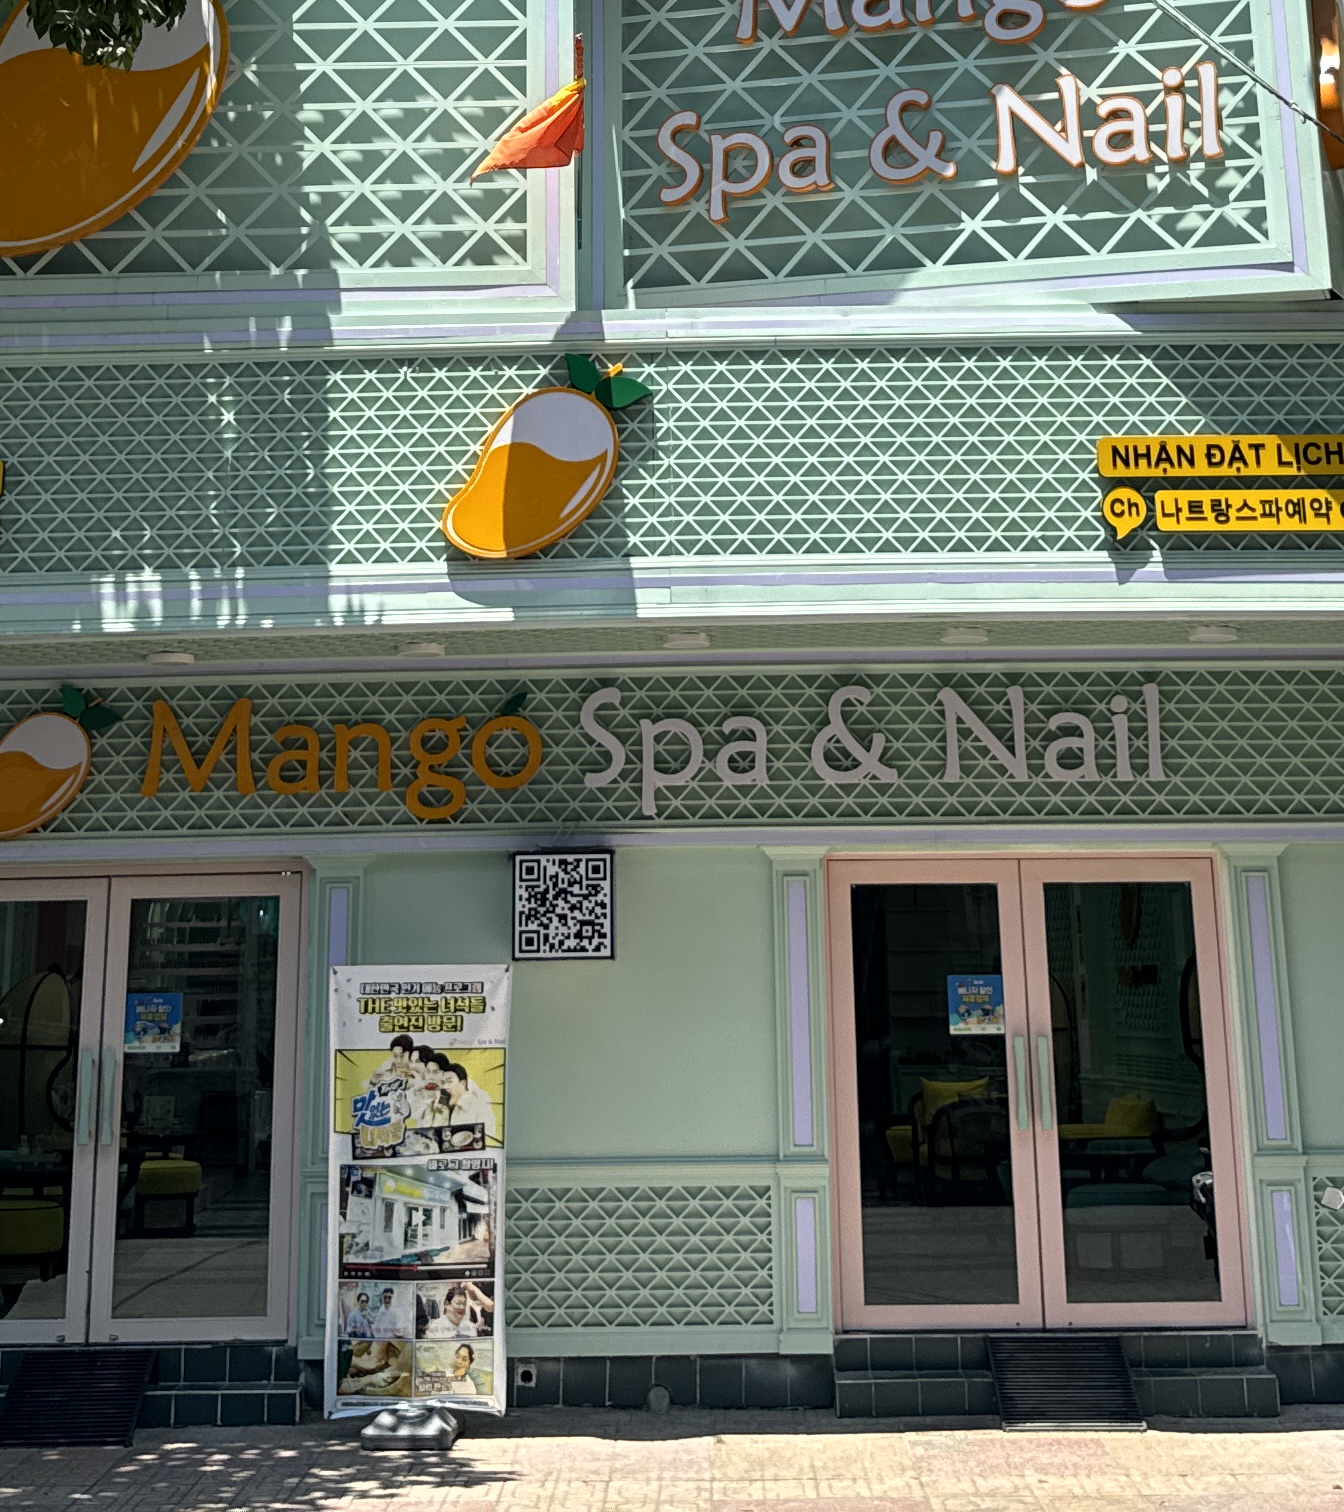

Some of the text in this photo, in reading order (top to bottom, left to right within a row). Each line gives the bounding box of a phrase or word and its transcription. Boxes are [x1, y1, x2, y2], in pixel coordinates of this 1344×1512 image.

[656, 61, 1223, 225] Spa & Nail
[1111, 441, 1344, 474] NHẬN ĐẶT LỊCH
[1109, 497, 1141, 518] Ch
[1160, 497, 1333, 526] 나트랑스파예약
[139, 683, 1166, 820] Mango Spa & Nail
[357, 997, 393, 1014] THE
